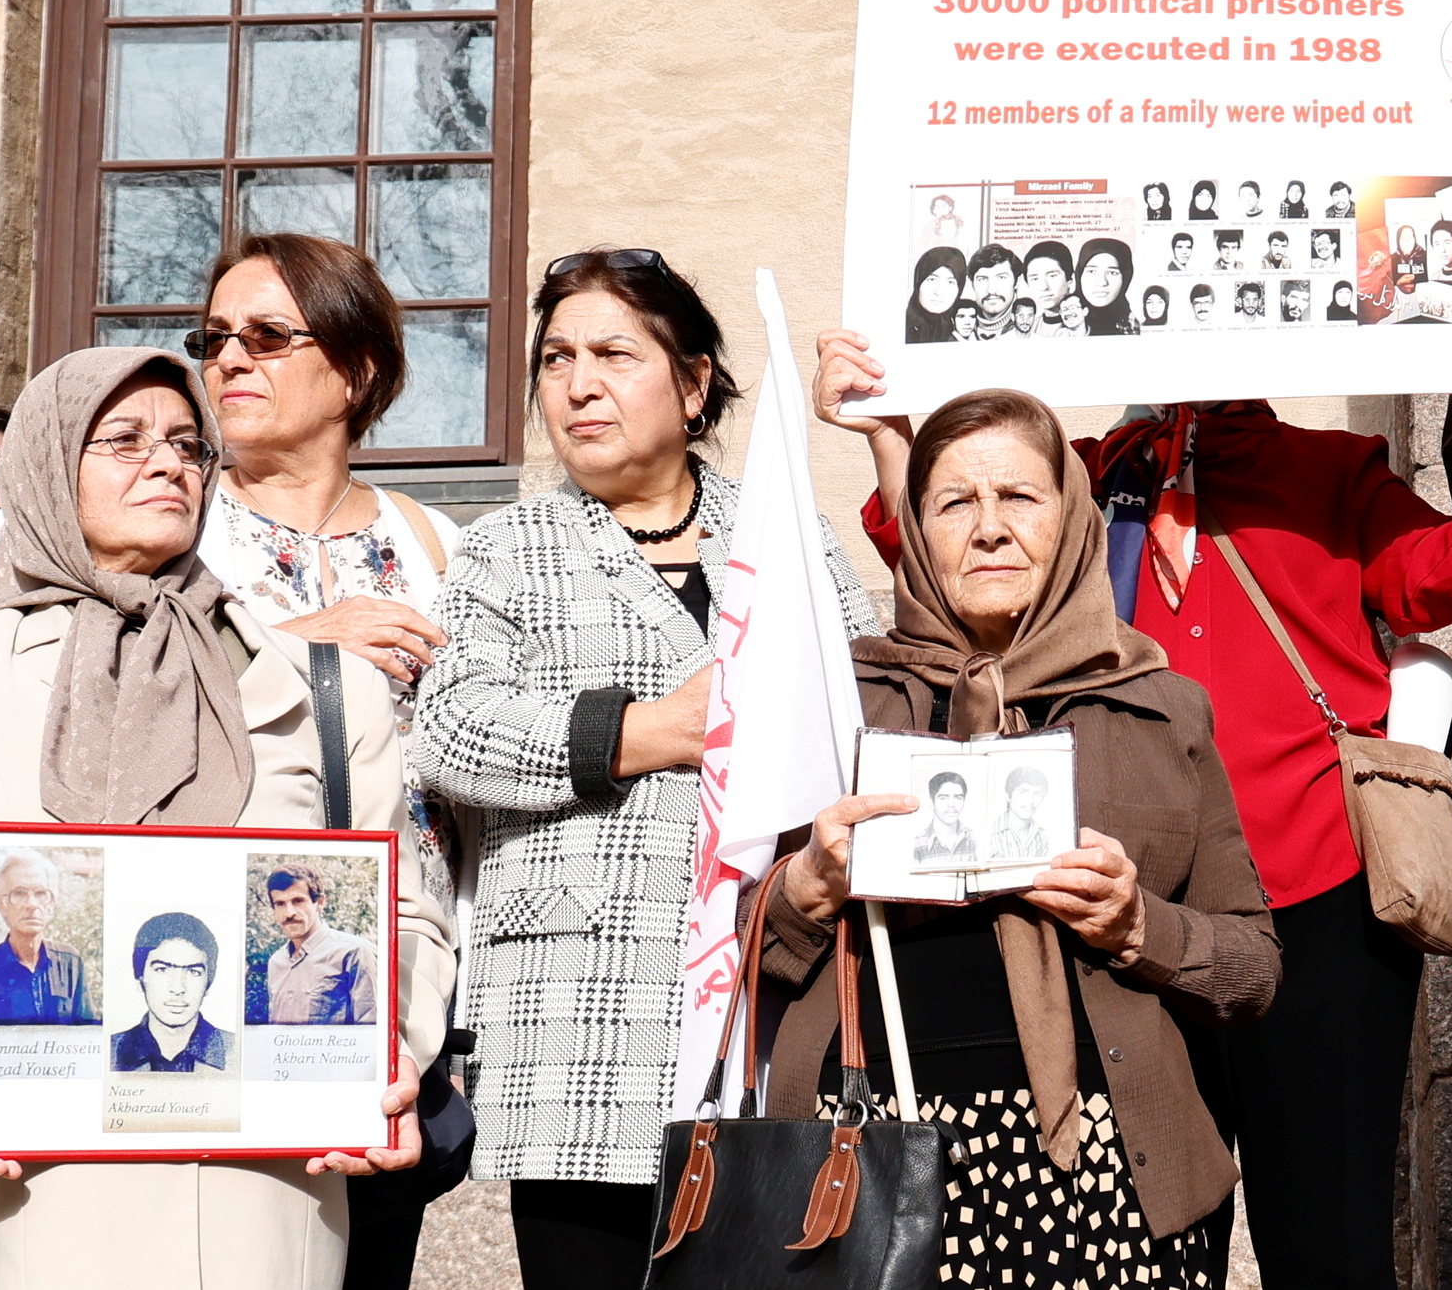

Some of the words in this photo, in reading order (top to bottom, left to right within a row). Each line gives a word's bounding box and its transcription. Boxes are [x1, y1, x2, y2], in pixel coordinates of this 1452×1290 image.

[953, 41, 1045, 61] were
[1055, 36, 1229, 61] executed
[1243, 36, 1276, 61] in
[1289, 37, 1382, 63] 1988
[927, 100, 957, 125] 12
[965, 99, 1080, 125] members
[1087, 99, 1113, 124] of
[1120, 105, 1133, 124] a
[1141, 98, 1218, 129] family
[1226, 104, 1285, 124] were
[1292, 99, 1365, 129] wiped
[1373, 100, 1414, 125] out
[1063, 181, 1094, 192] Family
[273, 1034, 323, 1047] Gholam
[327, 1034, 357, 1047] Reza
[42, 1041, 101, 1055] Hossein
[273, 1052, 315, 1064] Akbari
[319, 1052, 370, 1064] Namdar
[25, 1062, 77, 1079] Yousefi
[108, 1086, 145, 1097] Naser
[108, 1102, 166, 1115] Akbarzad
[168, 1101, 210, 1115] Yousefi
[109, 1118, 124, 1129] 19
